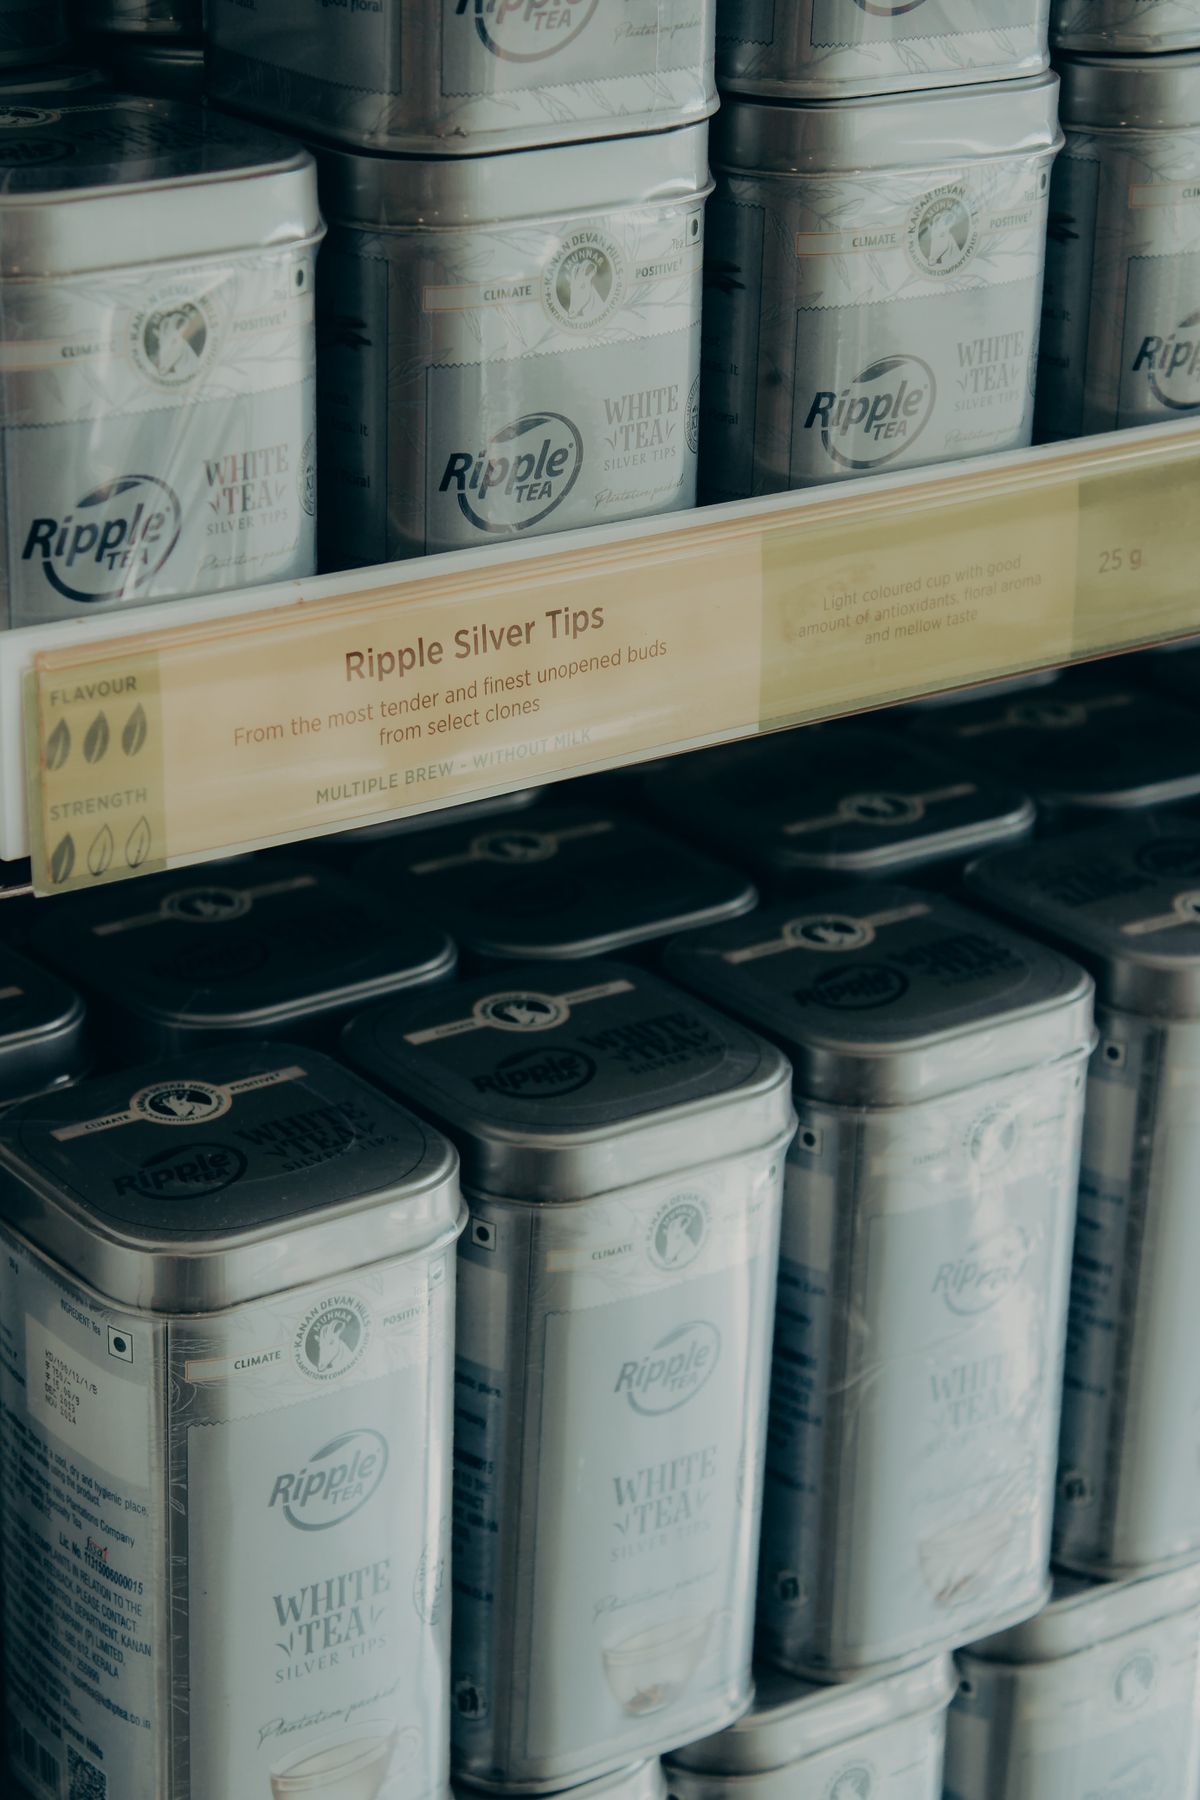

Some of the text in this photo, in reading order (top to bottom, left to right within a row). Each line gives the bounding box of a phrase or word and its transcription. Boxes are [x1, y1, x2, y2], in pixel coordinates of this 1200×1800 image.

[534, 9, 571, 31] TEA
[544, 240, 573, 289] KANAN
[571, 232, 606, 247] DEVAN
[852, 232, 897, 248] CLIMATE
[483, 284, 532, 301] CLIMATE
[956, 330, 1025, 368] WHITE
[968, 363, 1009, 394] TEA
[602, 384, 680, 425] WHITE
[803, 379, 925, 437] Ripple
[619, 419, 664, 452] TEA
[873, 420, 907, 441] TEA
[203, 444, 290, 488] WHITE
[438, 439, 570, 500] Ripple
[603, 446, 678, 472] SILVER TIPS
[222, 481, 274, 517] TEA
[515, 480, 552, 503] TEA
[21, 502, 166, 567] Ripple
[206, 516, 256, 537] SILVER
[1098, 546, 1144, 574] 25 g
[823, 554, 1022, 612] Light coloured cup with good
[798, 614, 851, 641] amount
[855, 610, 871, 627] of
[964, 582, 999, 603] floral
[1001, 572, 1043, 594] aroma
[864, 606, 978, 645] and mellow taste
[344, 603, 605, 682] Ripple Silver Tips
[50, 675, 138, 707] FLAVOUR
[233, 638, 668, 747] From the most tender and finest unopened buds
[379, 696, 541, 747] from select clones
[315, 771, 400, 806] MULTIPLE
[403, 759, 455, 786] BREW
[472, 739, 550, 769] WITHOUT
[553, 727, 592, 749] MILK
[50, 787, 148, 822] STRENGTH
[471, 1053, 581, 1094] Ripple
[84, 1113, 131, 1131] CLIMATE
[233, 1100, 368, 1147] WHITE
[112, 1148, 231, 1197] Ripple
[293, 1295, 371, 1350] KANAN DEVAN HILLS
[234, 1350, 281, 1370] CLIMATE
[614, 1341, 710, 1394] Ripple
[669, 1373, 699, 1392] TEA
[94, 1481, 121, 1507] hygienic
[267, 1450, 378, 1508] Ripple
[333, 1482, 364, 1506] TEA
[613, 1447, 718, 1508] WHITE
[634, 1490, 692, 1535] TEA
[100, 1519, 135, 1549] Company
[76, 1584, 100, 1613] PLEASE
[101, 1602, 136, 1634] CONTACT
[80, 1570, 111, 1603] RELATION
[113, 1592, 123, 1609] TO
[126, 1599, 142, 1617] THE
[272, 1558, 392, 1627] WHITE
[96, 1636, 125, 1665] LIMITED,
[121, 1632, 151, 1657] KANAN
[298, 1604, 366, 1656] TEA
[92, 1651, 119, 1681] KERALA
[275, 1633, 388, 1685] SILVER TIPS
